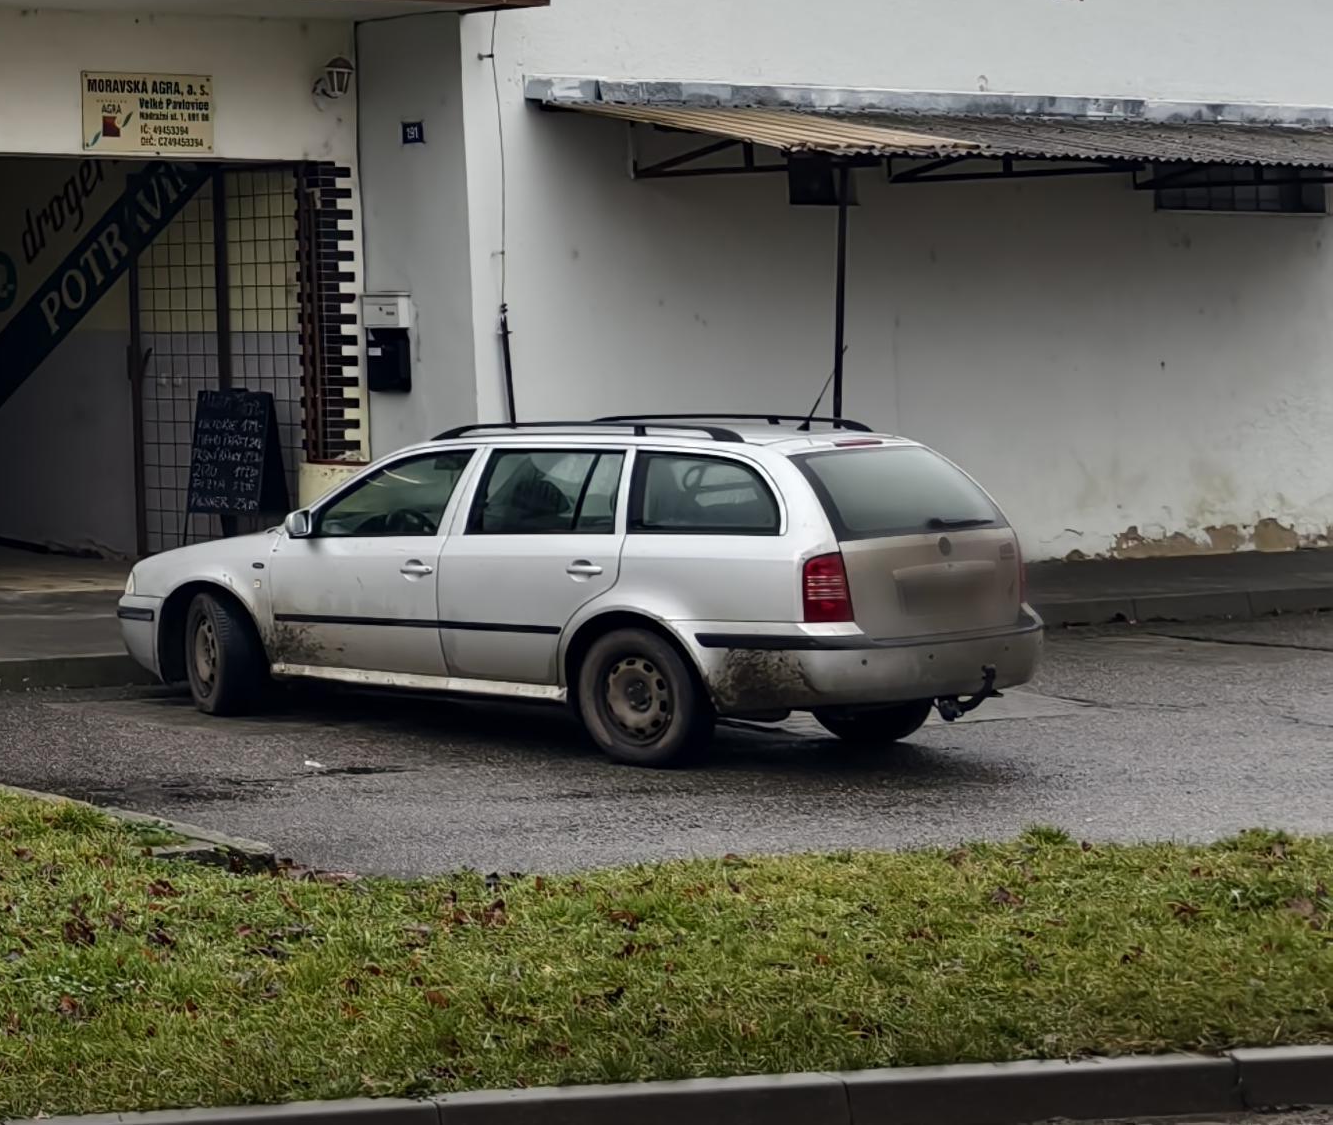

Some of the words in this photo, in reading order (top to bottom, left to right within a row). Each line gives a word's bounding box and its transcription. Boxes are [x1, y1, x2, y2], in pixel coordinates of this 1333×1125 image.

[87, 77, 148, 95] MORAVSKÁ
[151, 81, 184, 97] AGRA,
[187, 84, 197, 96] a.
[199, 84, 209, 96] s.
[101, 103, 122, 114] AGRA
[138, 98, 164, 110] Velké
[166, 98, 209, 111] Pavlovice
